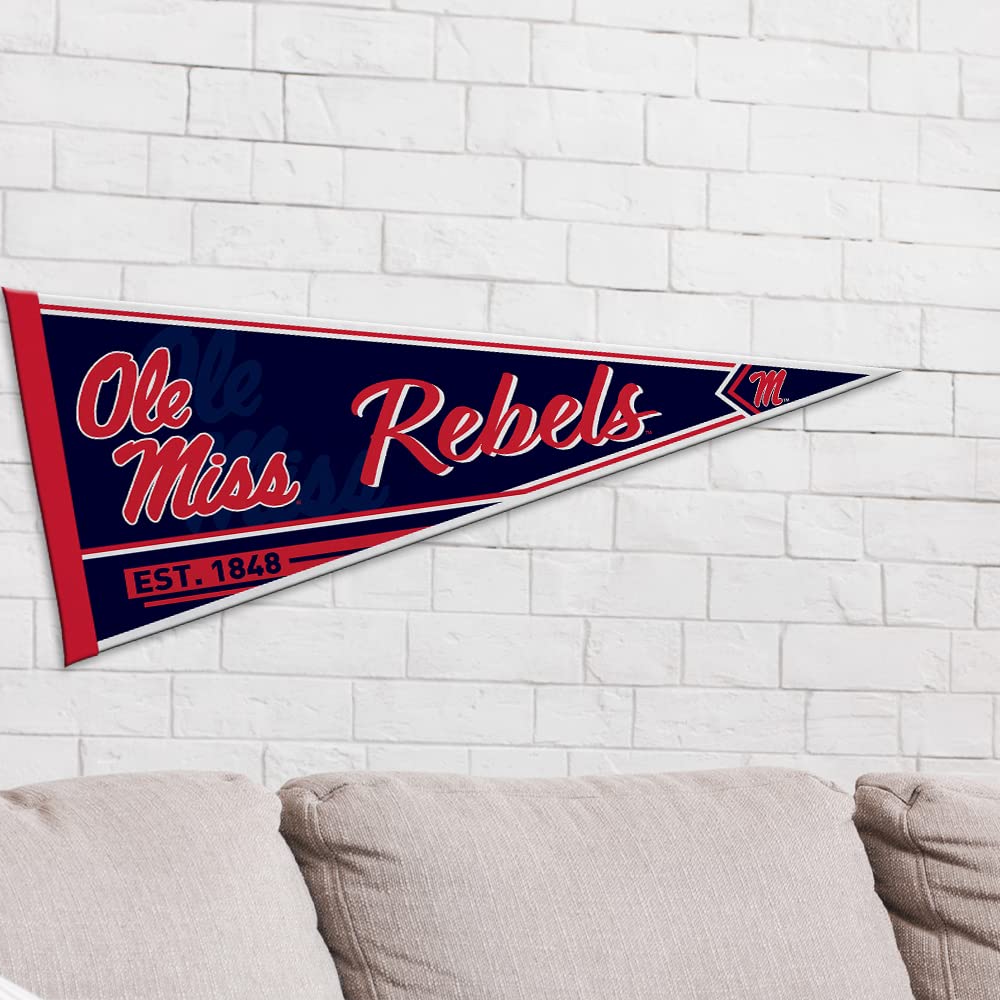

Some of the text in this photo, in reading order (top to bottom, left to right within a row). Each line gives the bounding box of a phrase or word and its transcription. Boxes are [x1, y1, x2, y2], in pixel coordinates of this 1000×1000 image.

[76, 346, 193, 440] Ole
[351, 363, 663, 488] Rebels
[749, 368, 788, 409] M
[112, 432, 300, 526] Miss
[133, 551, 282, 595] EST. 1848
